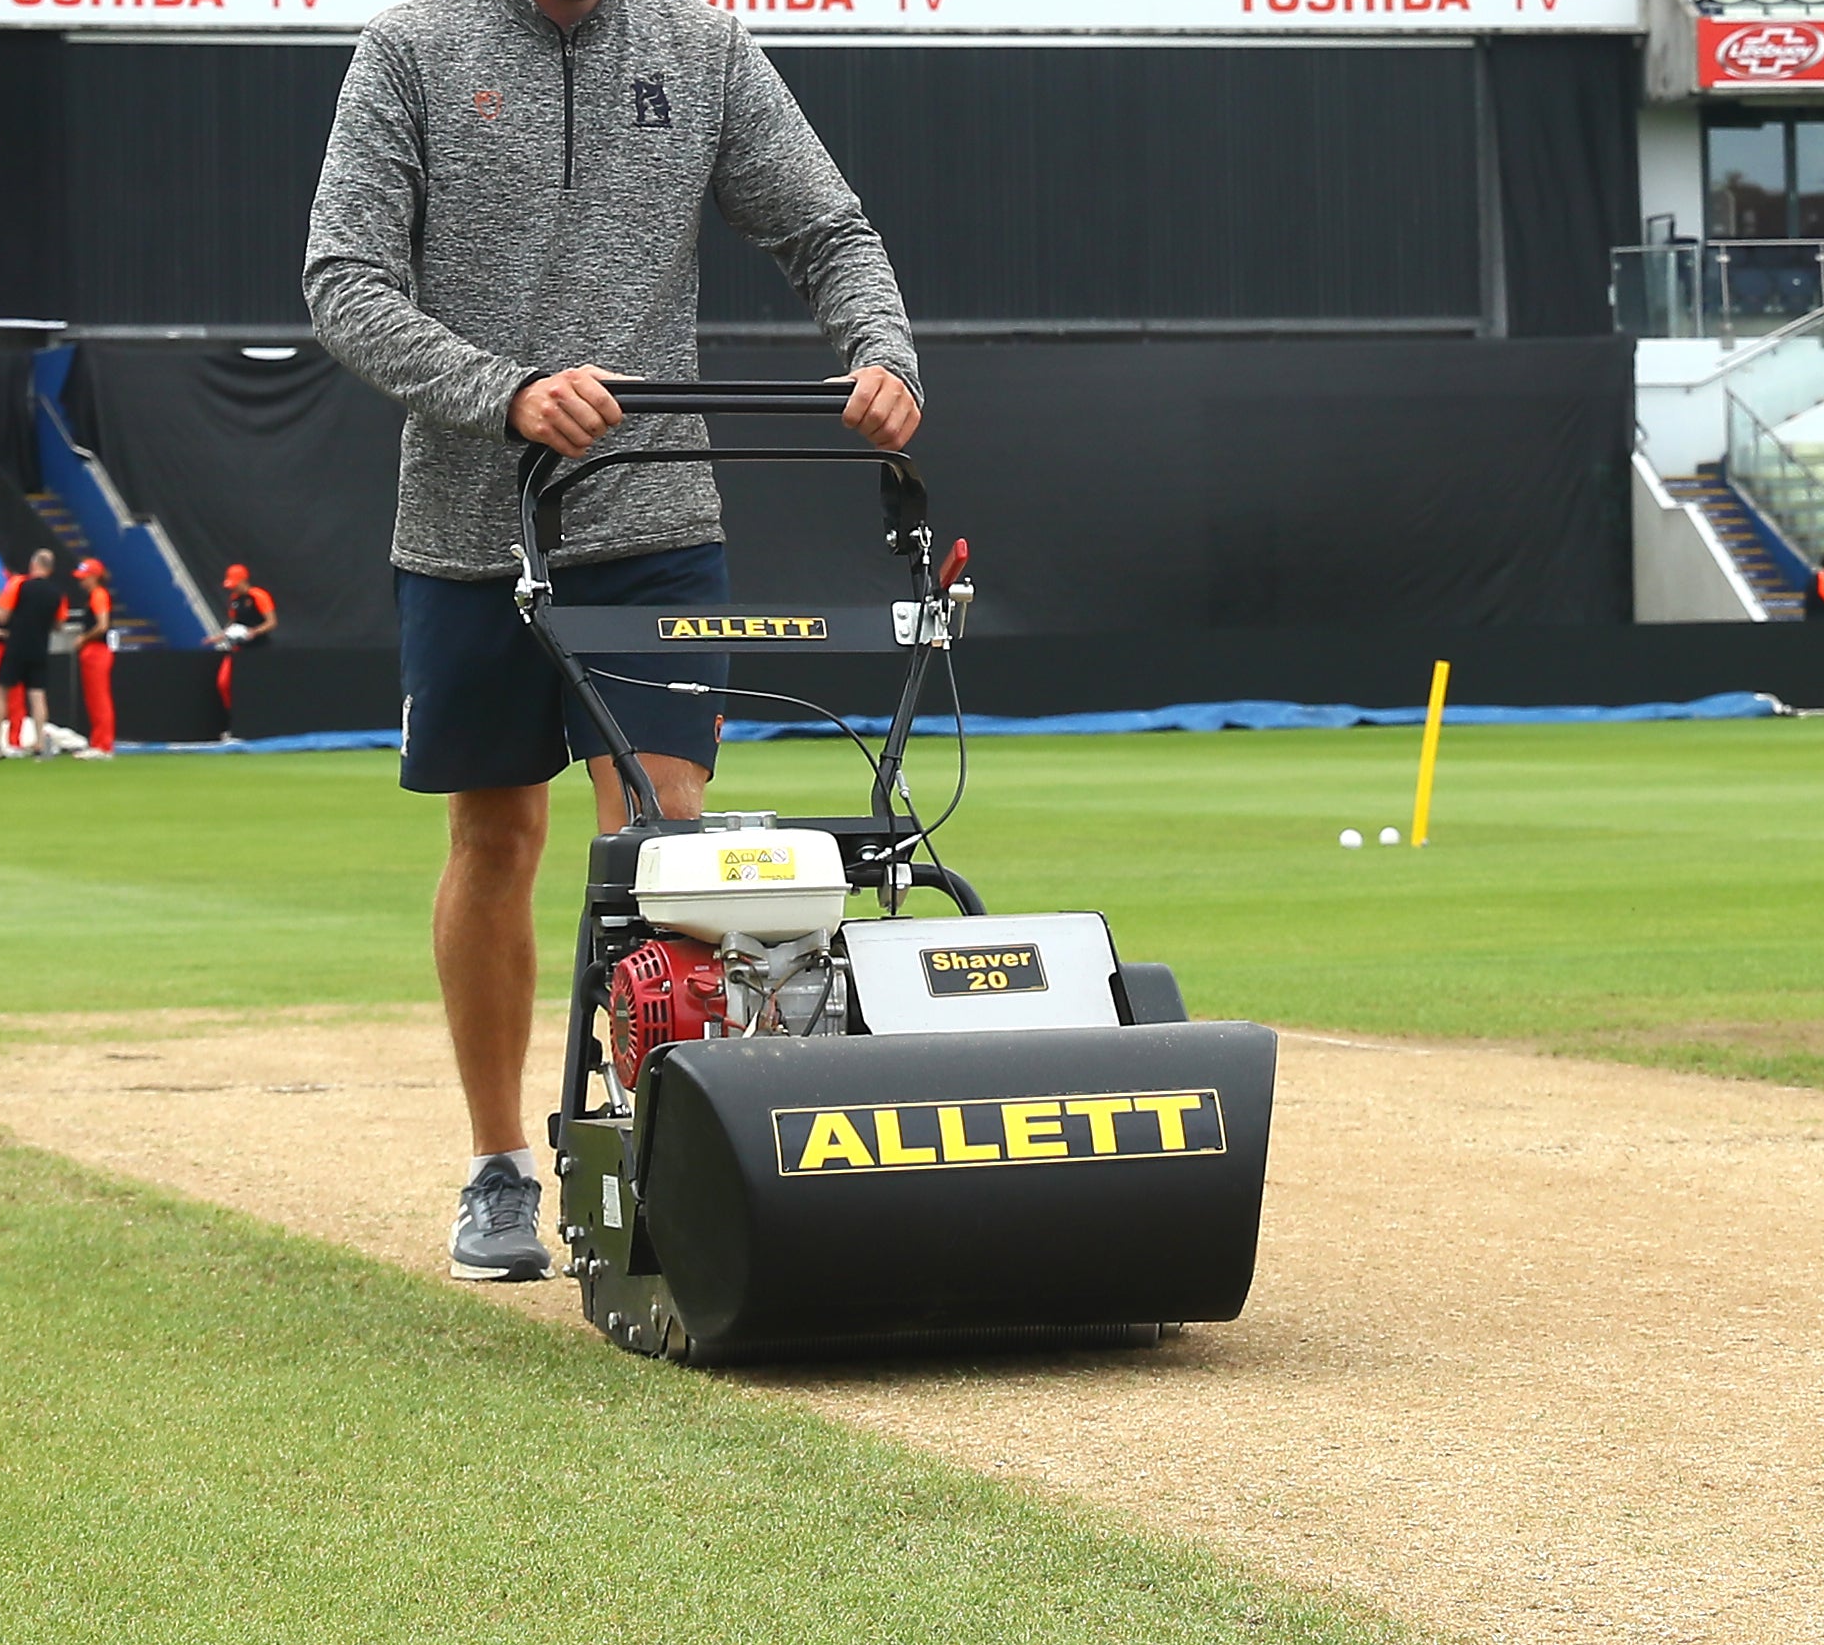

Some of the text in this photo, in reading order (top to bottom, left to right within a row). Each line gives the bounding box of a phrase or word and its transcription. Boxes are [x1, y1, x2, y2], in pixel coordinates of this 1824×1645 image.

[672, 619, 815, 636] ALLETT
[931, 952, 1031, 971] Shaver
[967, 970, 1008, 990] 20
[801, 1096, 1201, 1168] ALLETT
